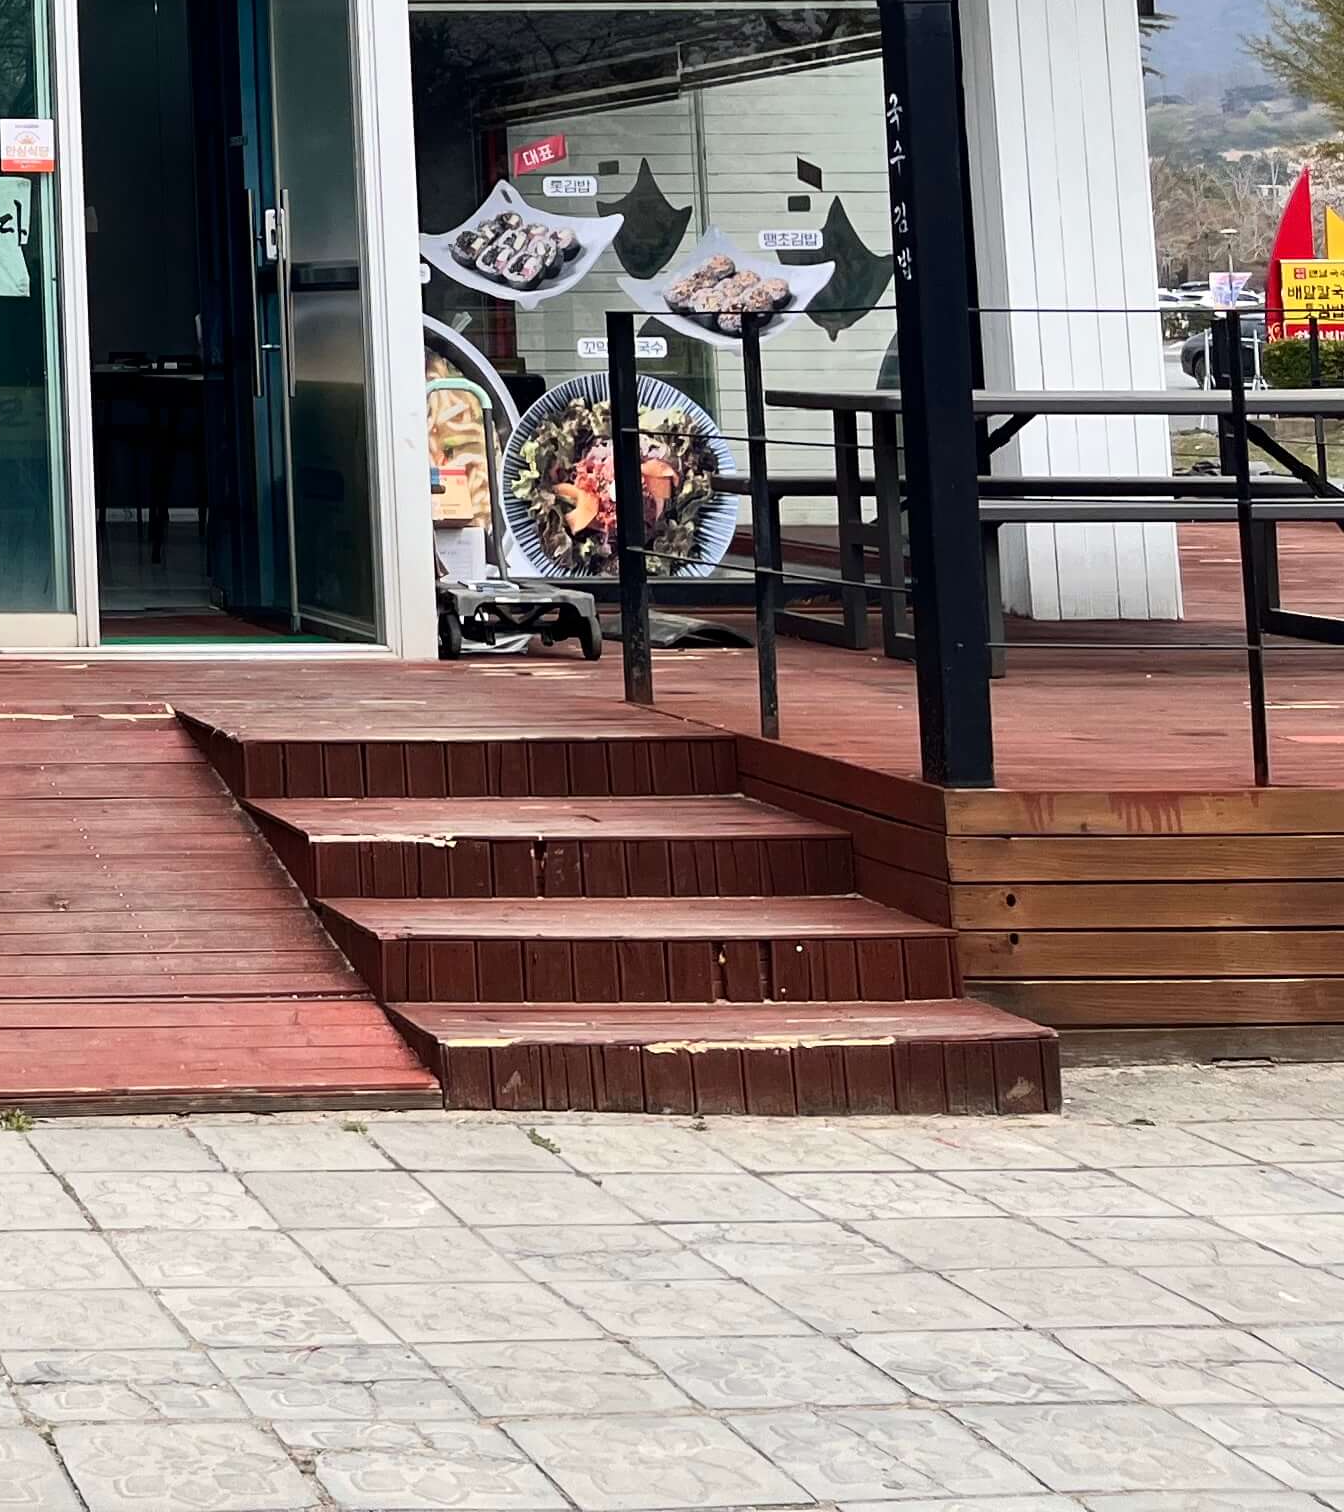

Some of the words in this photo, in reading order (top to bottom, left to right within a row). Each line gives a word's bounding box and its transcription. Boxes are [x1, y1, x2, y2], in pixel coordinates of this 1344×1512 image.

[886, 92, 907, 176] 국수
[522, 143, 555, 166] 대표
[550, 179, 591, 193] 톳김밥
[763, 232, 817, 247] 땡초김밥
[583, 340, 664, 355] 꼬막국수
